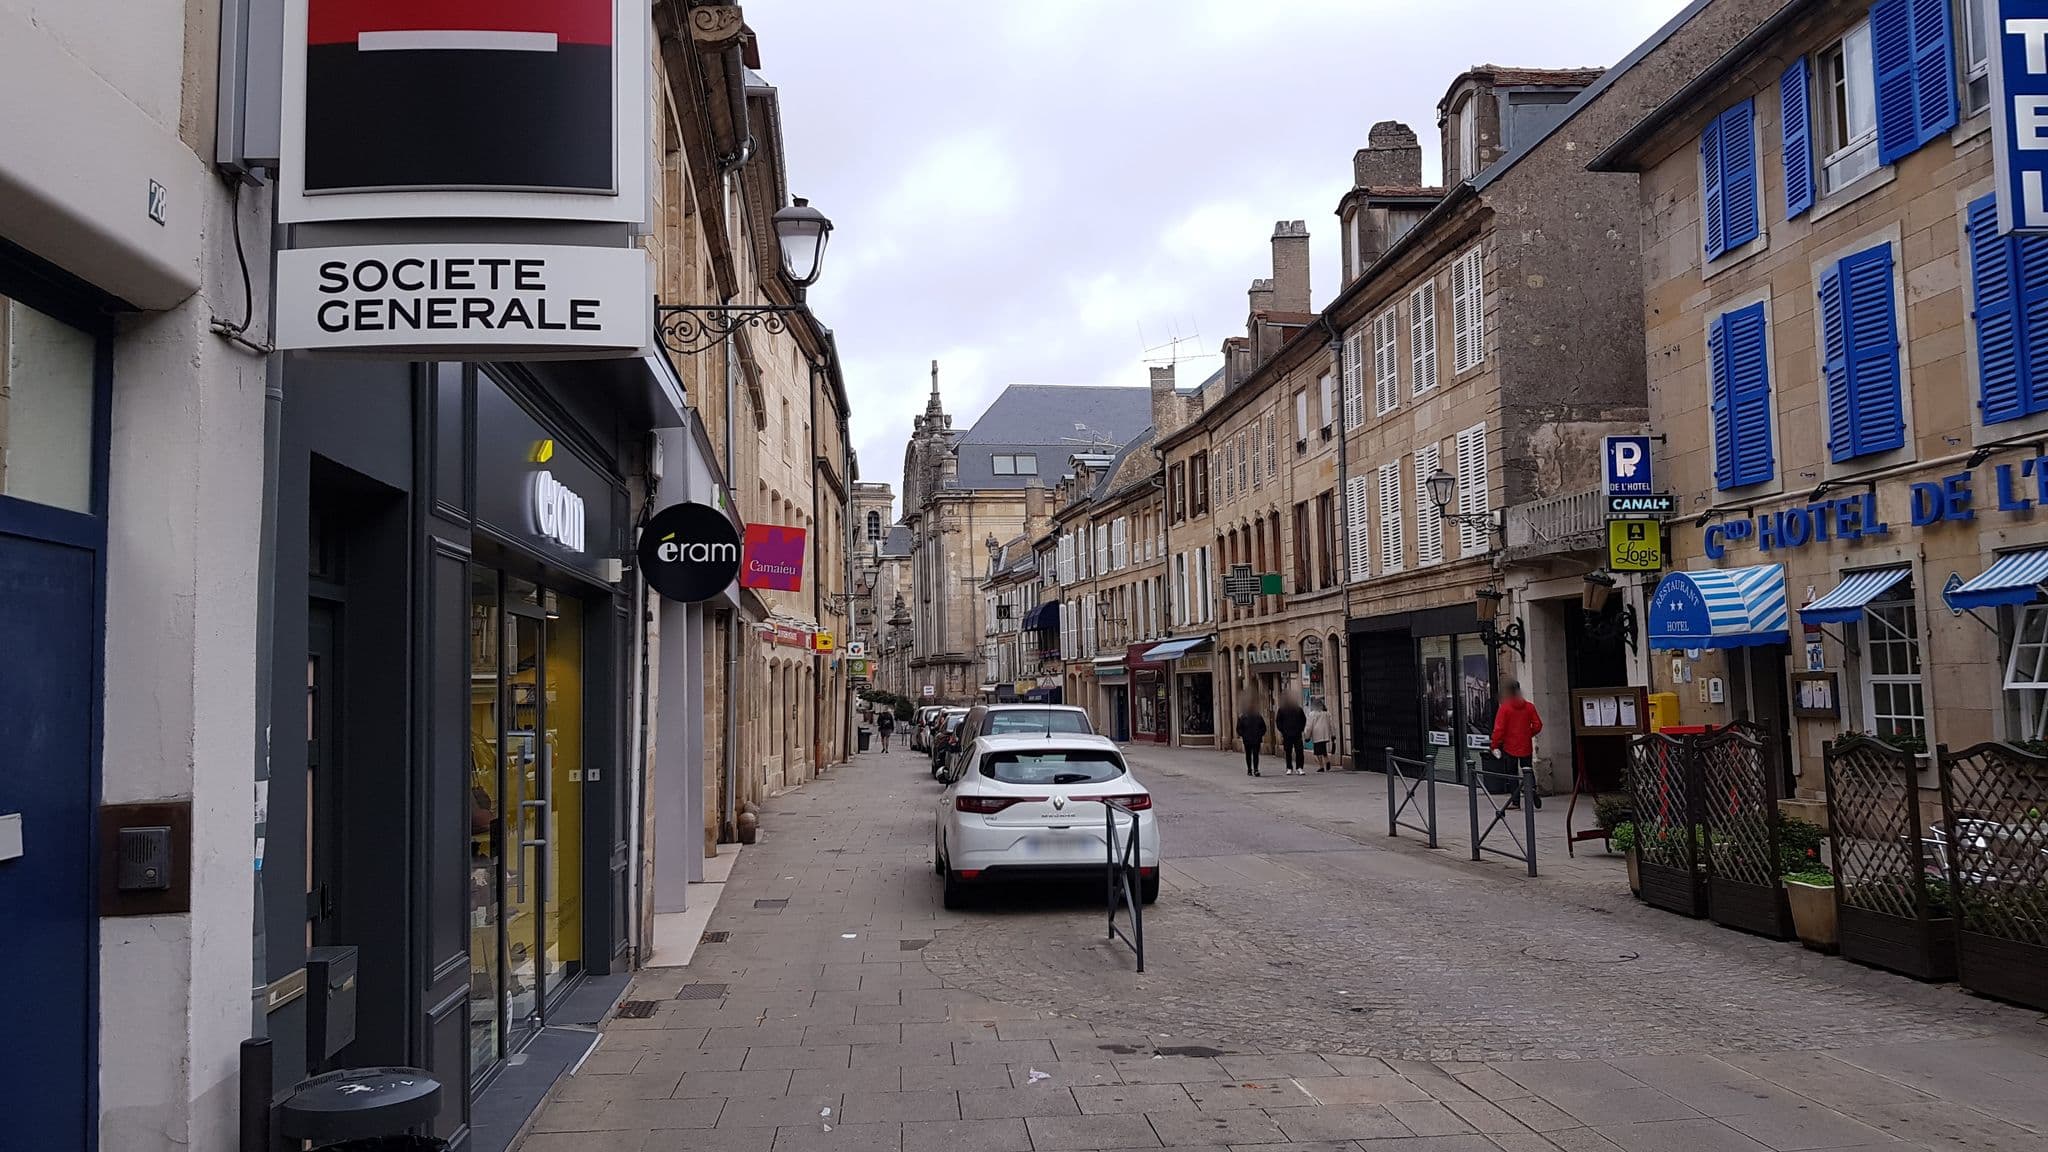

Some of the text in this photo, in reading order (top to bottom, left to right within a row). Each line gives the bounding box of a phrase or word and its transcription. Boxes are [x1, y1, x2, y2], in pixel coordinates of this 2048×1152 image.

[151, 182, 166, 221] 28
[319, 258, 546, 293] SOCIETE
[317, 298, 602, 333] GENERALE
[1609, 483, 1620, 491] DE
[1612, 498, 1670, 510] CANAL+
[1758, 494, 1888, 551] HOTEL
[1911, 471, 1978, 526] DE
[657, 532, 737, 562] éram
[1615, 541, 1659, 567] Logis
[1655, 579, 1700, 608] RESTAURANT
[1666, 621, 1690, 631] HOTEL
